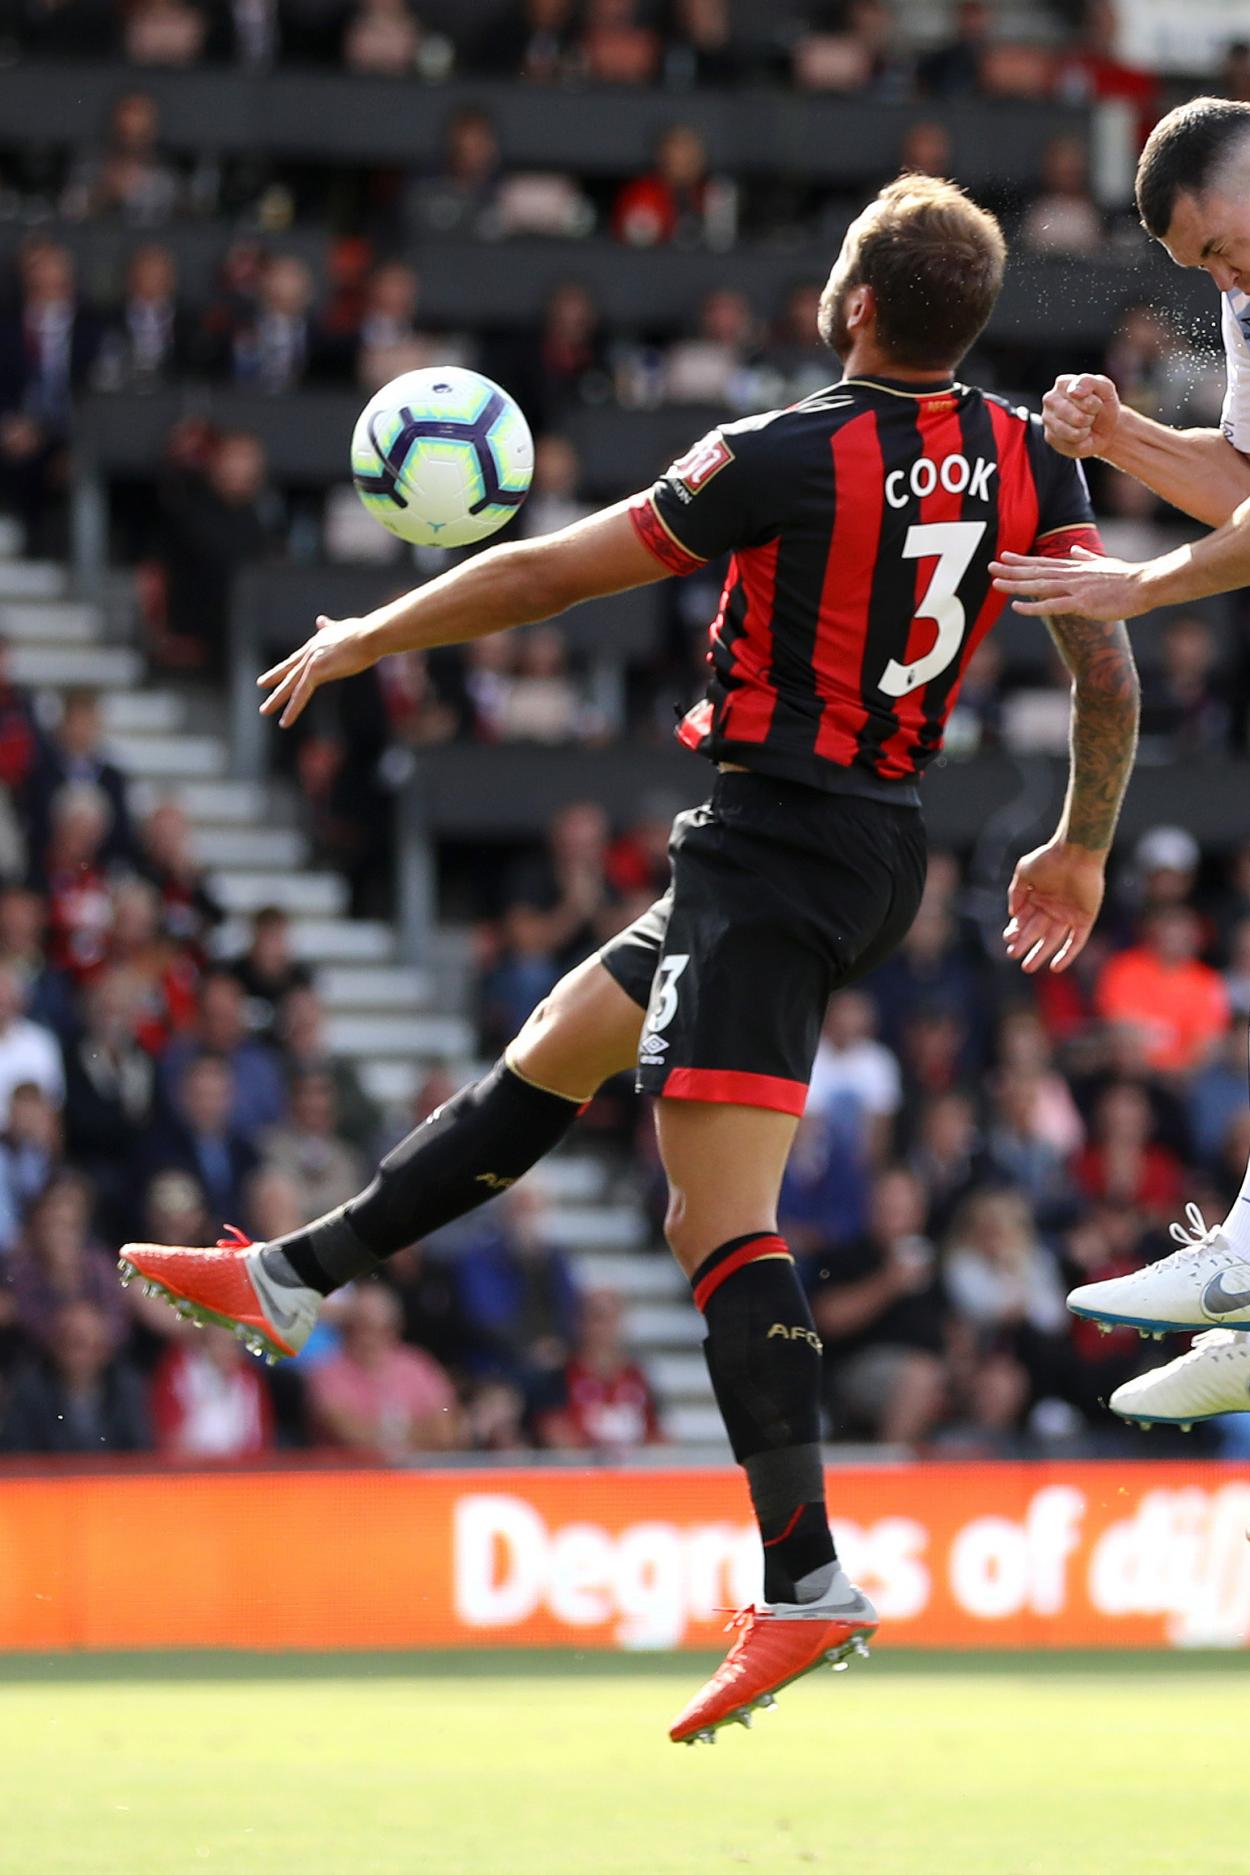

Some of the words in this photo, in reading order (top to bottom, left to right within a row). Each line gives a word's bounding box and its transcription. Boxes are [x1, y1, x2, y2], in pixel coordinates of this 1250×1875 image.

[885, 453, 997, 509] COOK
[877, 521, 987, 697] 3
[647, 953, 690, 1033] 3
[948, 1485, 1085, 1618] of
